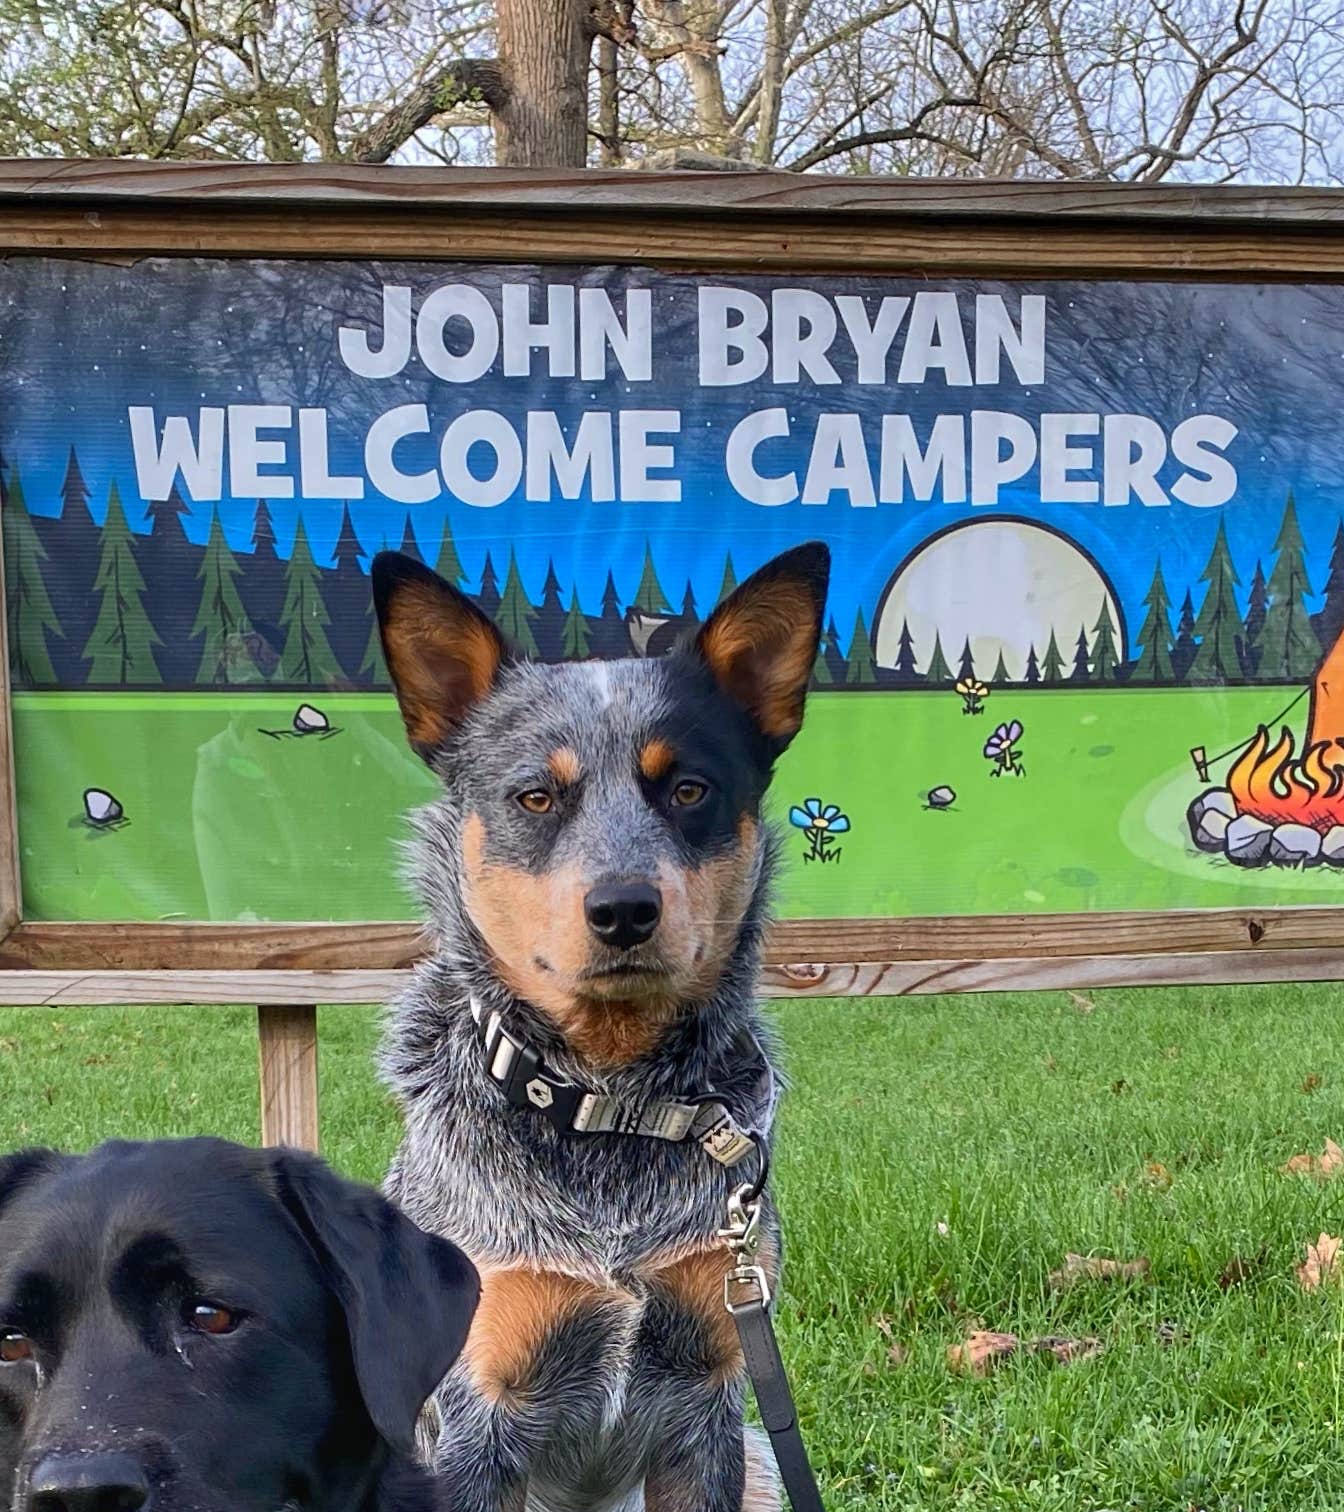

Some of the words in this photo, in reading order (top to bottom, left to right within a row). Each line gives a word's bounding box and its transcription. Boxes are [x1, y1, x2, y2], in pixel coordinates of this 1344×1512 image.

[337, 282, 653, 384] JOHN
[697, 285, 1047, 387] BRYAN
[127, 402, 682, 508] WELCOME
[724, 406, 1240, 508] CAMPERS
